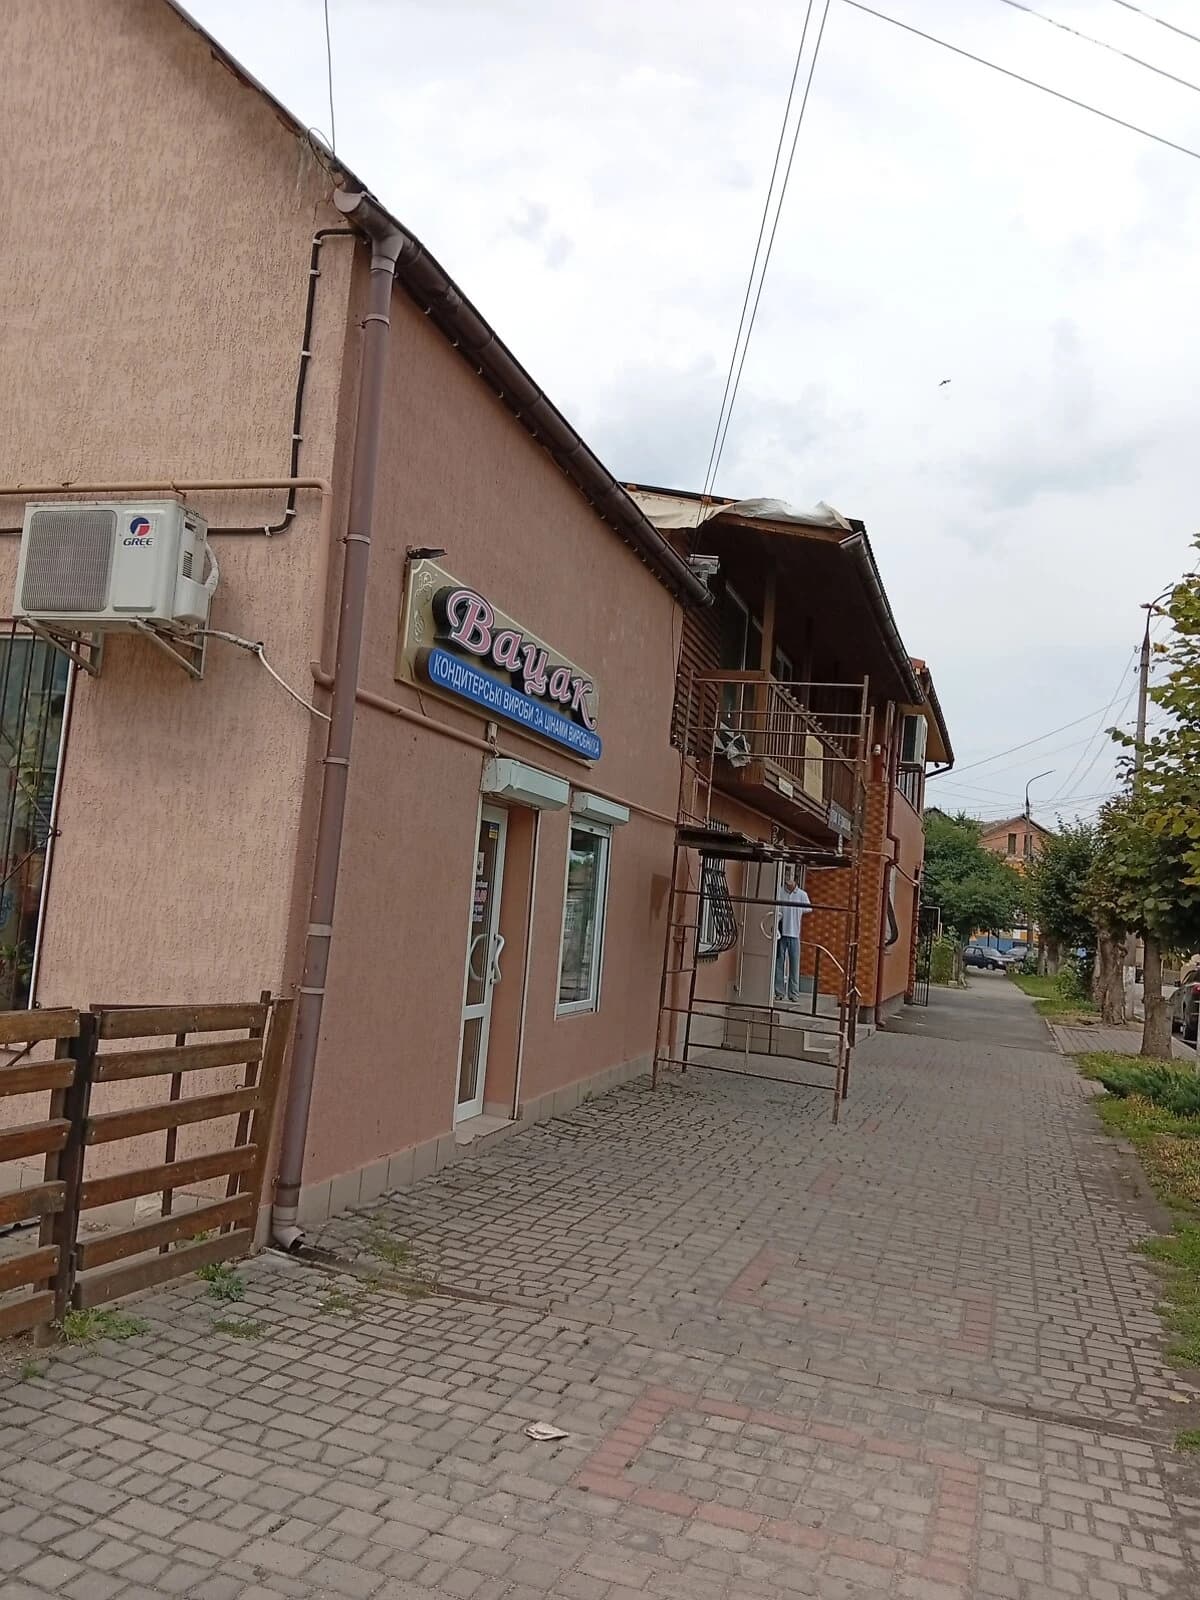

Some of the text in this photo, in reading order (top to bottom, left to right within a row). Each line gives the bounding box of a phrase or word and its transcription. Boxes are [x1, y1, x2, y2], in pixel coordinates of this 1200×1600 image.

[123, 537, 153, 546] GREE
[433, 653, 503, 706] КОНДИТЕРСЬКІ
[503, 691, 534, 722] ВИРОБИ
[534, 708, 544, 728] ЗА
[544, 713, 569, 739] ЦІНАМИ
[447, 589, 597, 731] Вацак
